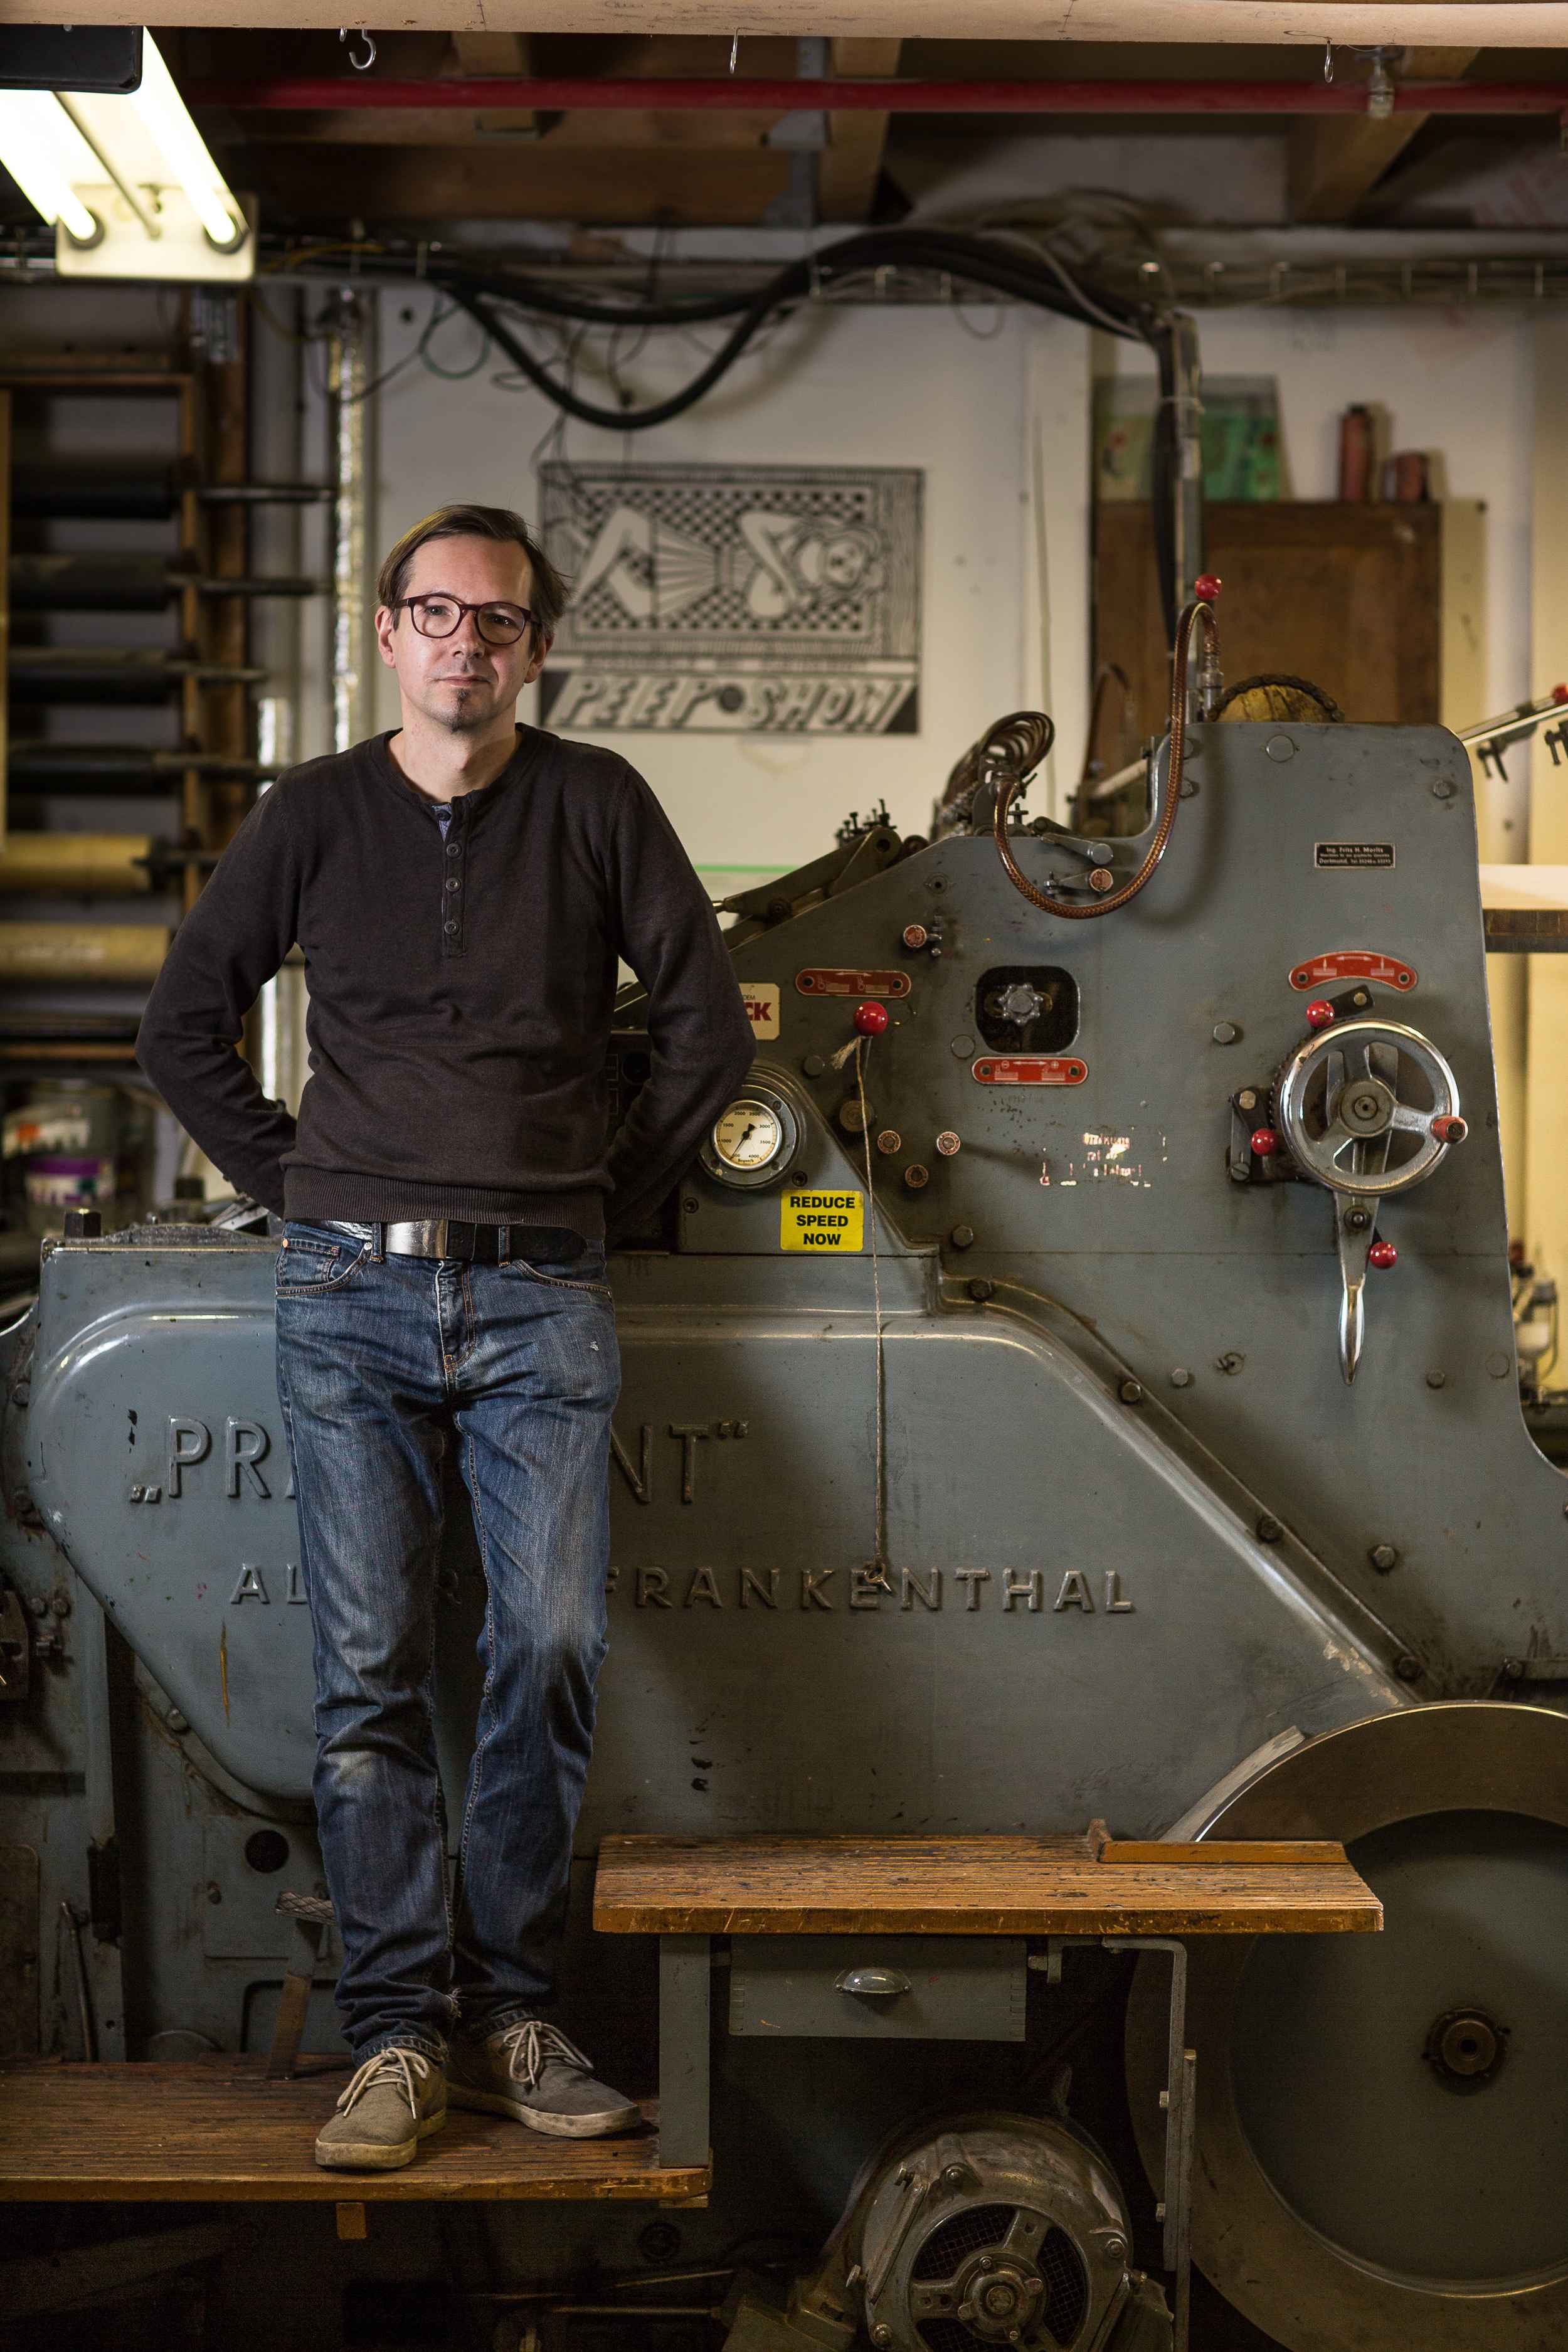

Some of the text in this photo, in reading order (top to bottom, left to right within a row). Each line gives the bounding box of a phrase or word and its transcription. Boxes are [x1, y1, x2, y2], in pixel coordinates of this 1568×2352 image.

[552, 675, 904, 731] PEEP SHOW
[790, 1195, 856, 1209] REDUCE
[796, 1214, 849, 1227] SPEED
[803, 1232, 842, 1245] NOW
